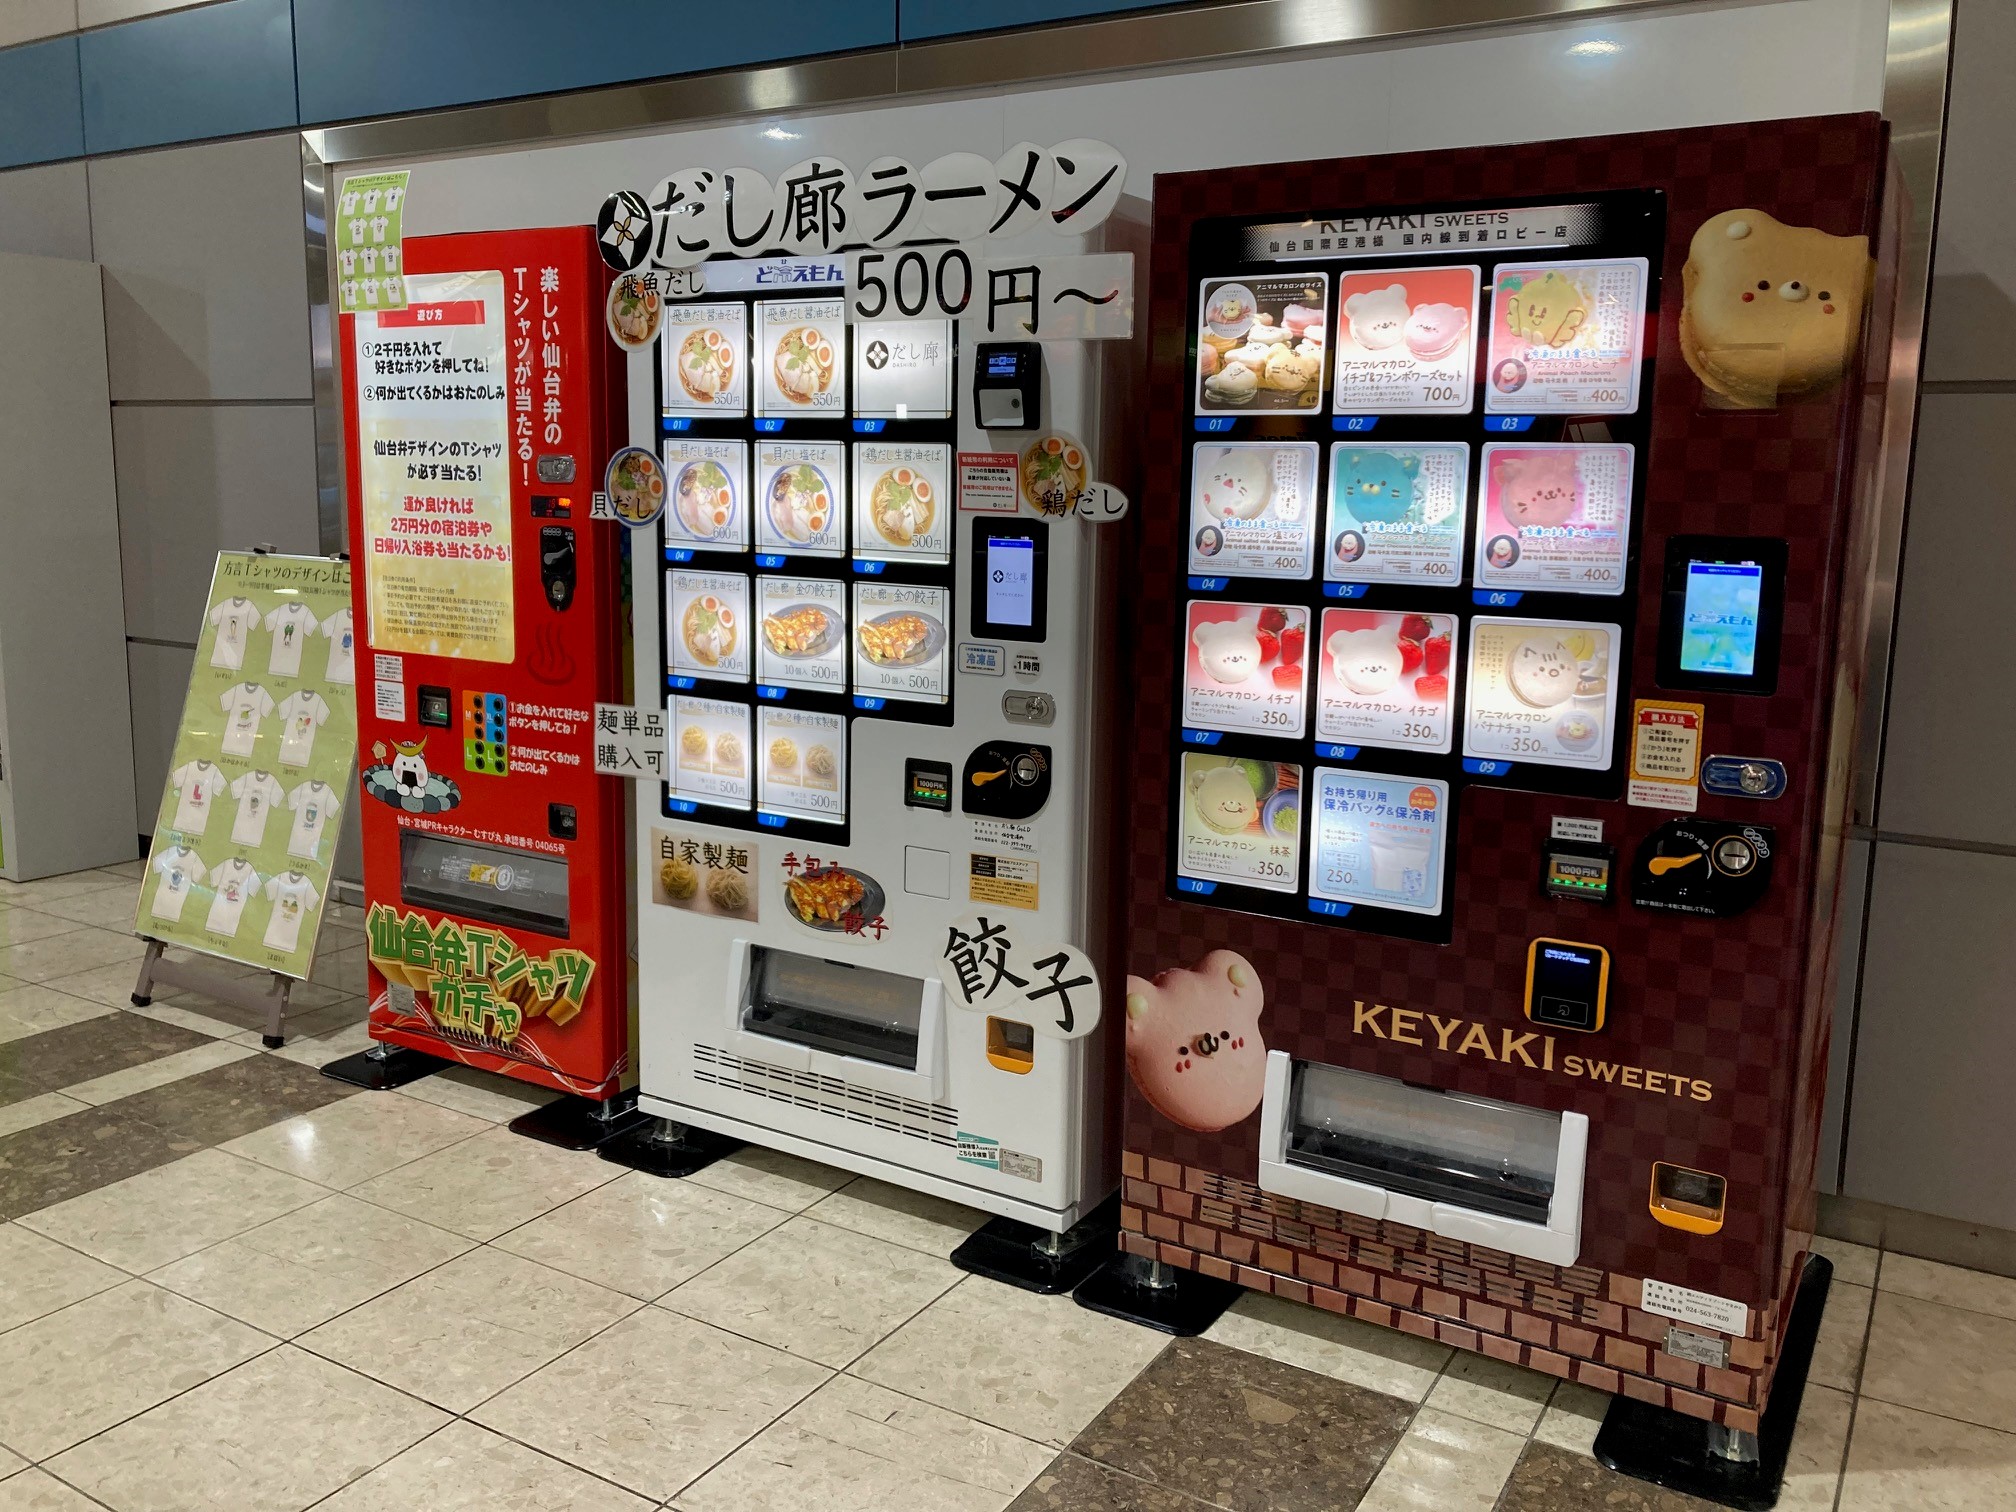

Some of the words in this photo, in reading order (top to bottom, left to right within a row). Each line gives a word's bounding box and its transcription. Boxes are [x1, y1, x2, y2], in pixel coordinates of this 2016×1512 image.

[651, 150, 1118, 253] だし廊ラーメン
[1434, 212, 1509, 227] SWEETS
[1269, 235, 1384, 254] 仙台国際空港様
[1402, 225, 1568, 246] 国内線到着ロビー店
[620, 270, 704, 299] 飛魚だし
[1256, 281, 1323, 290] アニマルマカロンのサイズ
[416, 308, 443, 322] 遊び方
[672, 308, 741, 322] 飛魚だし醤油そば
[767, 306, 840, 322] 飛魚だし醤油そば
[540, 266, 561, 445] 楽しい仙台弁の
[892, 340, 939, 366] だし廊
[1343, 359, 1417, 371] アニマルマカロン
[1342, 370, 1462, 385] イチゴ&フランボワーズセット
[714, 391, 740, 405] 550円
[812, 392, 841, 407] 550円
[1423, 386, 1460, 402] 700円
[673, 421, 683, 430] 01
[765, 421, 775, 430] 02
[864, 421, 875, 431] 03
[1209, 419, 1222, 430] 01
[1348, 418, 1363, 430] 02
[1501, 418, 1518, 430] 03
[374, 439, 502, 459] 仙台弁デザインのTシャツ
[680, 444, 729, 459] 貝だし塩そば
[773, 446, 826, 462] 貝だし塩そば
[865, 447, 942, 462] 鶏だし生醤油そば
[403, 495, 474, 515] 運が良ければ
[592, 493, 651, 519] 貝だし
[1041, 487, 1124, 517] 鶏だし
[391, 517, 493, 538] 2万円分の宿泊券や
[713, 525, 739, 541] 600円
[808, 532, 837, 546] 600円
[912, 534, 942, 549] 500円
[675, 551, 685, 560] 04
[766, 557, 776, 566] 05
[865, 562, 875, 572] 06
[676, 575, 741, 592] 鶏だし生醤油そば
[1202, 579, 1215, 589] 04
[1338, 585, 1354, 596] 05
[1490, 593, 1506, 604] 06
[718, 656, 744, 671] 500円
[966, 653, 996, 667] 冷凍品
[811, 665, 839, 680] 500円
[677, 678, 687, 688] 07
[909, 675, 938, 690] 500円
[767, 688, 777, 698] 08
[1190, 687, 1261, 702] アニマルマカロン
[1267, 694, 1294, 704] イチゴ
[864, 698, 875, 708] 09
[1324, 698, 1402, 713] アニマルマカロン
[1409, 706, 1439, 717] イチゴ
[597, 707, 664, 738] 麺単品
[1475, 709, 1552, 723] アニマルマカロン
[1475, 721, 1531, 734] バナナチョコ
[1195, 732, 1209, 742] 07
[1330, 746, 1345, 757] 08
[597, 744, 664, 775] 購入可
[1479, 761, 1496, 773] 09
[510, 761, 548, 775] おたのしみ
[811, 794, 838, 809] 500円
[1324, 786, 1387, 803] お持ち帰り用
[680, 803, 688, 811] 10
[1324, 798, 1435, 822] 保冷バッグ&保冷剤
[769, 816, 777, 825] 11
[473, 829, 502, 843] むすび丸
[535, 839, 566, 854] 04065号
[1187, 835, 1256, 852] アニマルマカロン
[1269, 844, 1291, 858] 抹茶
[660, 835, 749, 875] 自家製麺
[1191, 881, 1203, 891] 10
[1324, 903, 1336, 913] 11
[842, 911, 889, 940] 餃子
[367, 902, 596, 1015] 仙台弁Tシャツ
[944, 916, 1093, 1033] 餃子
[429, 972, 522, 1037] ガチャ
[1352, 1000, 1556, 1071] KEYAKI
[1563, 1055, 1713, 1102] SWEETS
